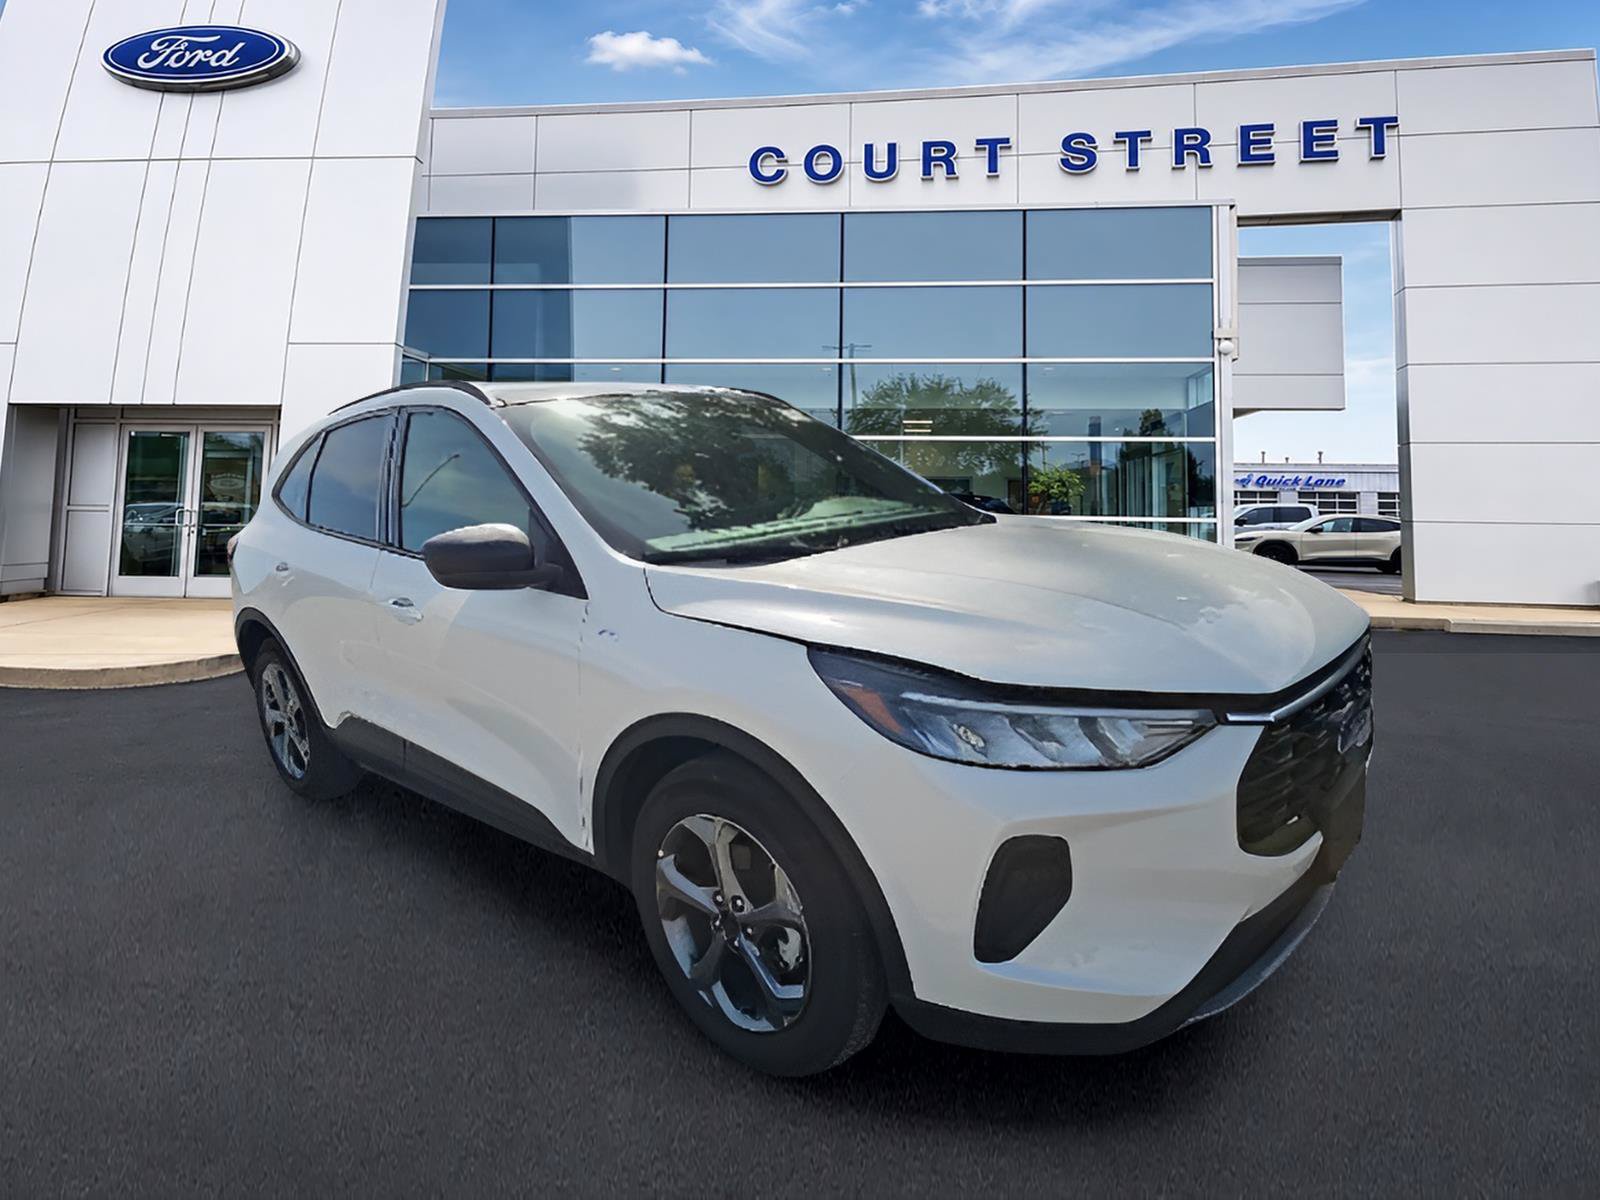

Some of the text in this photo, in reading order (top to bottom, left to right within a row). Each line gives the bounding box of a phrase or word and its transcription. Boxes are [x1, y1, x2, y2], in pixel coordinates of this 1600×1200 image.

[137, 35, 246, 69] Ford
[749, 115, 1400, 185] COURT STREET
[1255, 475, 1346, 488] Quick Lane
